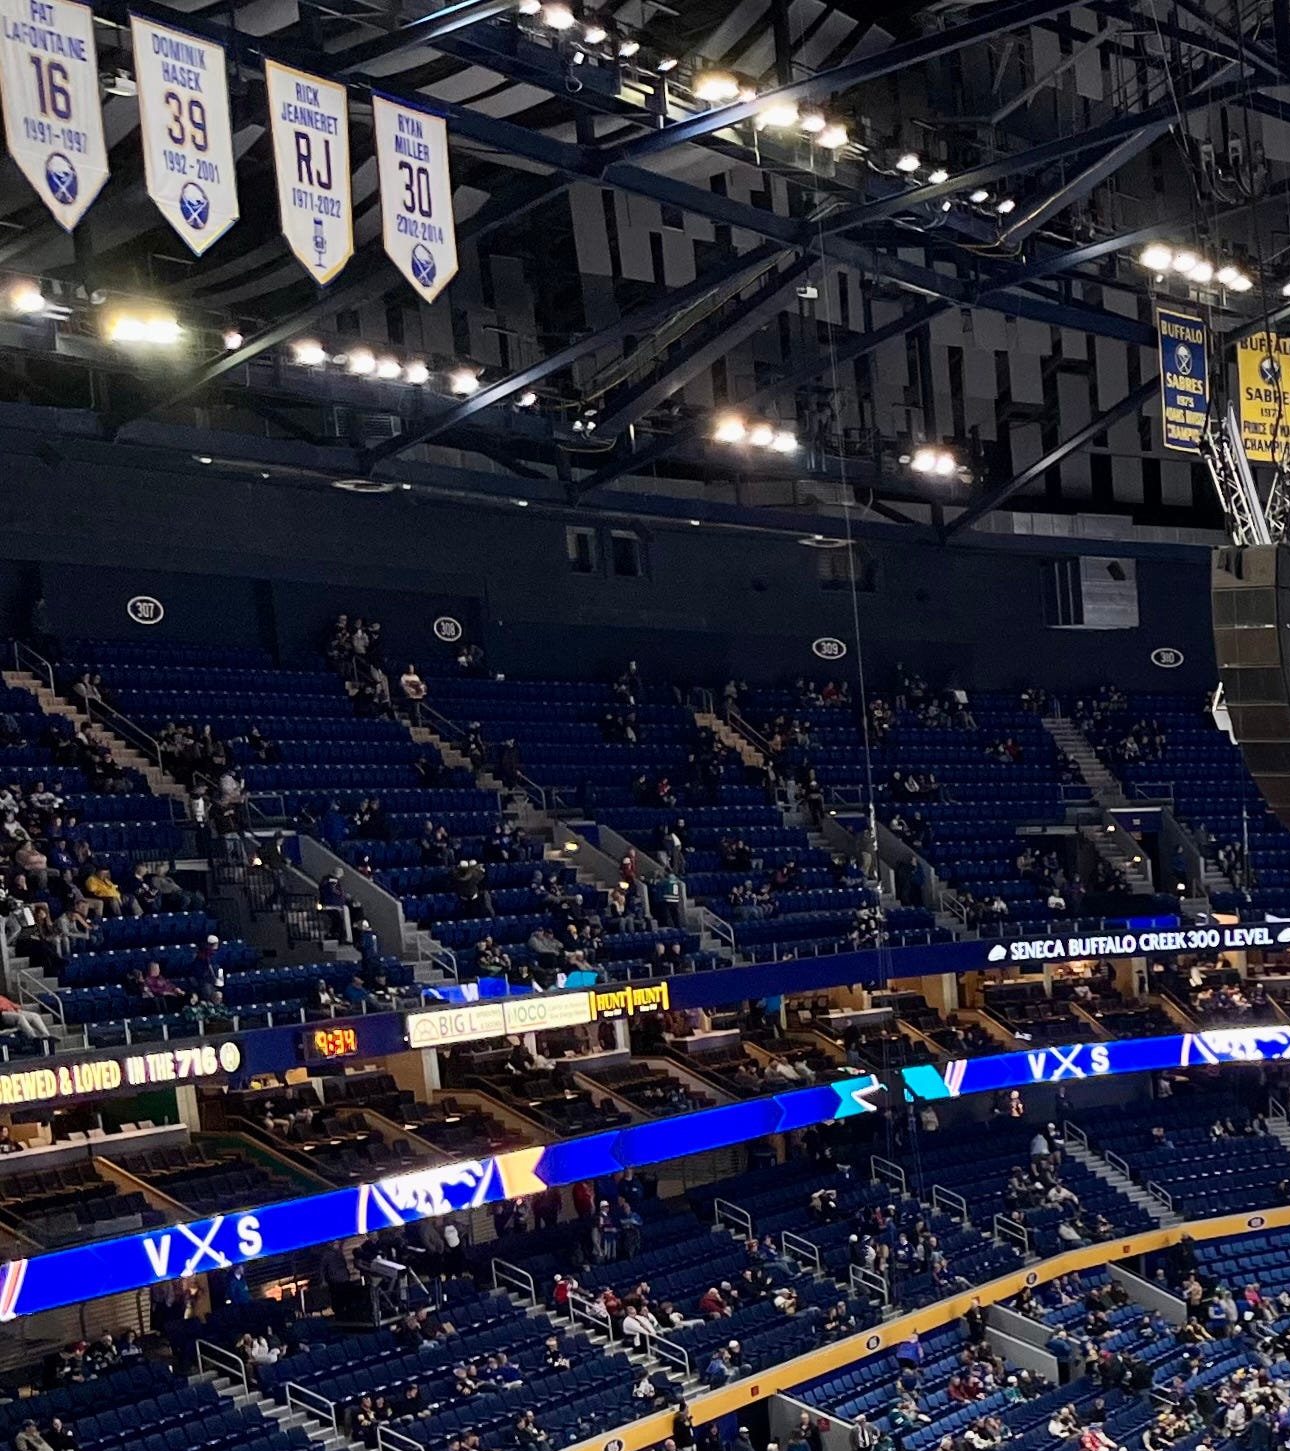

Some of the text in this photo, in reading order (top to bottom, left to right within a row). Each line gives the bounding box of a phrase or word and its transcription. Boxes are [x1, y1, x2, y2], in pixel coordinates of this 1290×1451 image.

[30, 1, 55, 25] PAT
[3, 16, 87, 62] LAFONTAINE
[151, 33, 206, 70] DOMINIK
[30, 55, 72, 120] 16
[162, 61, 202, 93] HASEK
[295, 82, 320, 108] RICK
[165, 91, 208, 151] 39
[281, 102, 338, 136] JEANNERET
[397, 113, 423, 139] RYAN
[294, 130, 332, 191] RJ
[395, 134, 430, 163] MILLER
[399, 160, 432, 218] 30
[1161, 320, 1203, 344] BUFFALO
[1166, 372, 1203, 395] SABRES
[1010, 928, 1273, 961] SENECA BUFFALO CREEK 300 LEVEL
[597, 990, 626, 1012] HUNT
[633, 986, 661, 1008] HUNT
[438, 1013, 466, 1036] BIG
[469, 1014, 478, 1032] L
[0, 1046, 216, 1104] REWED & LOVED IN THE 716
